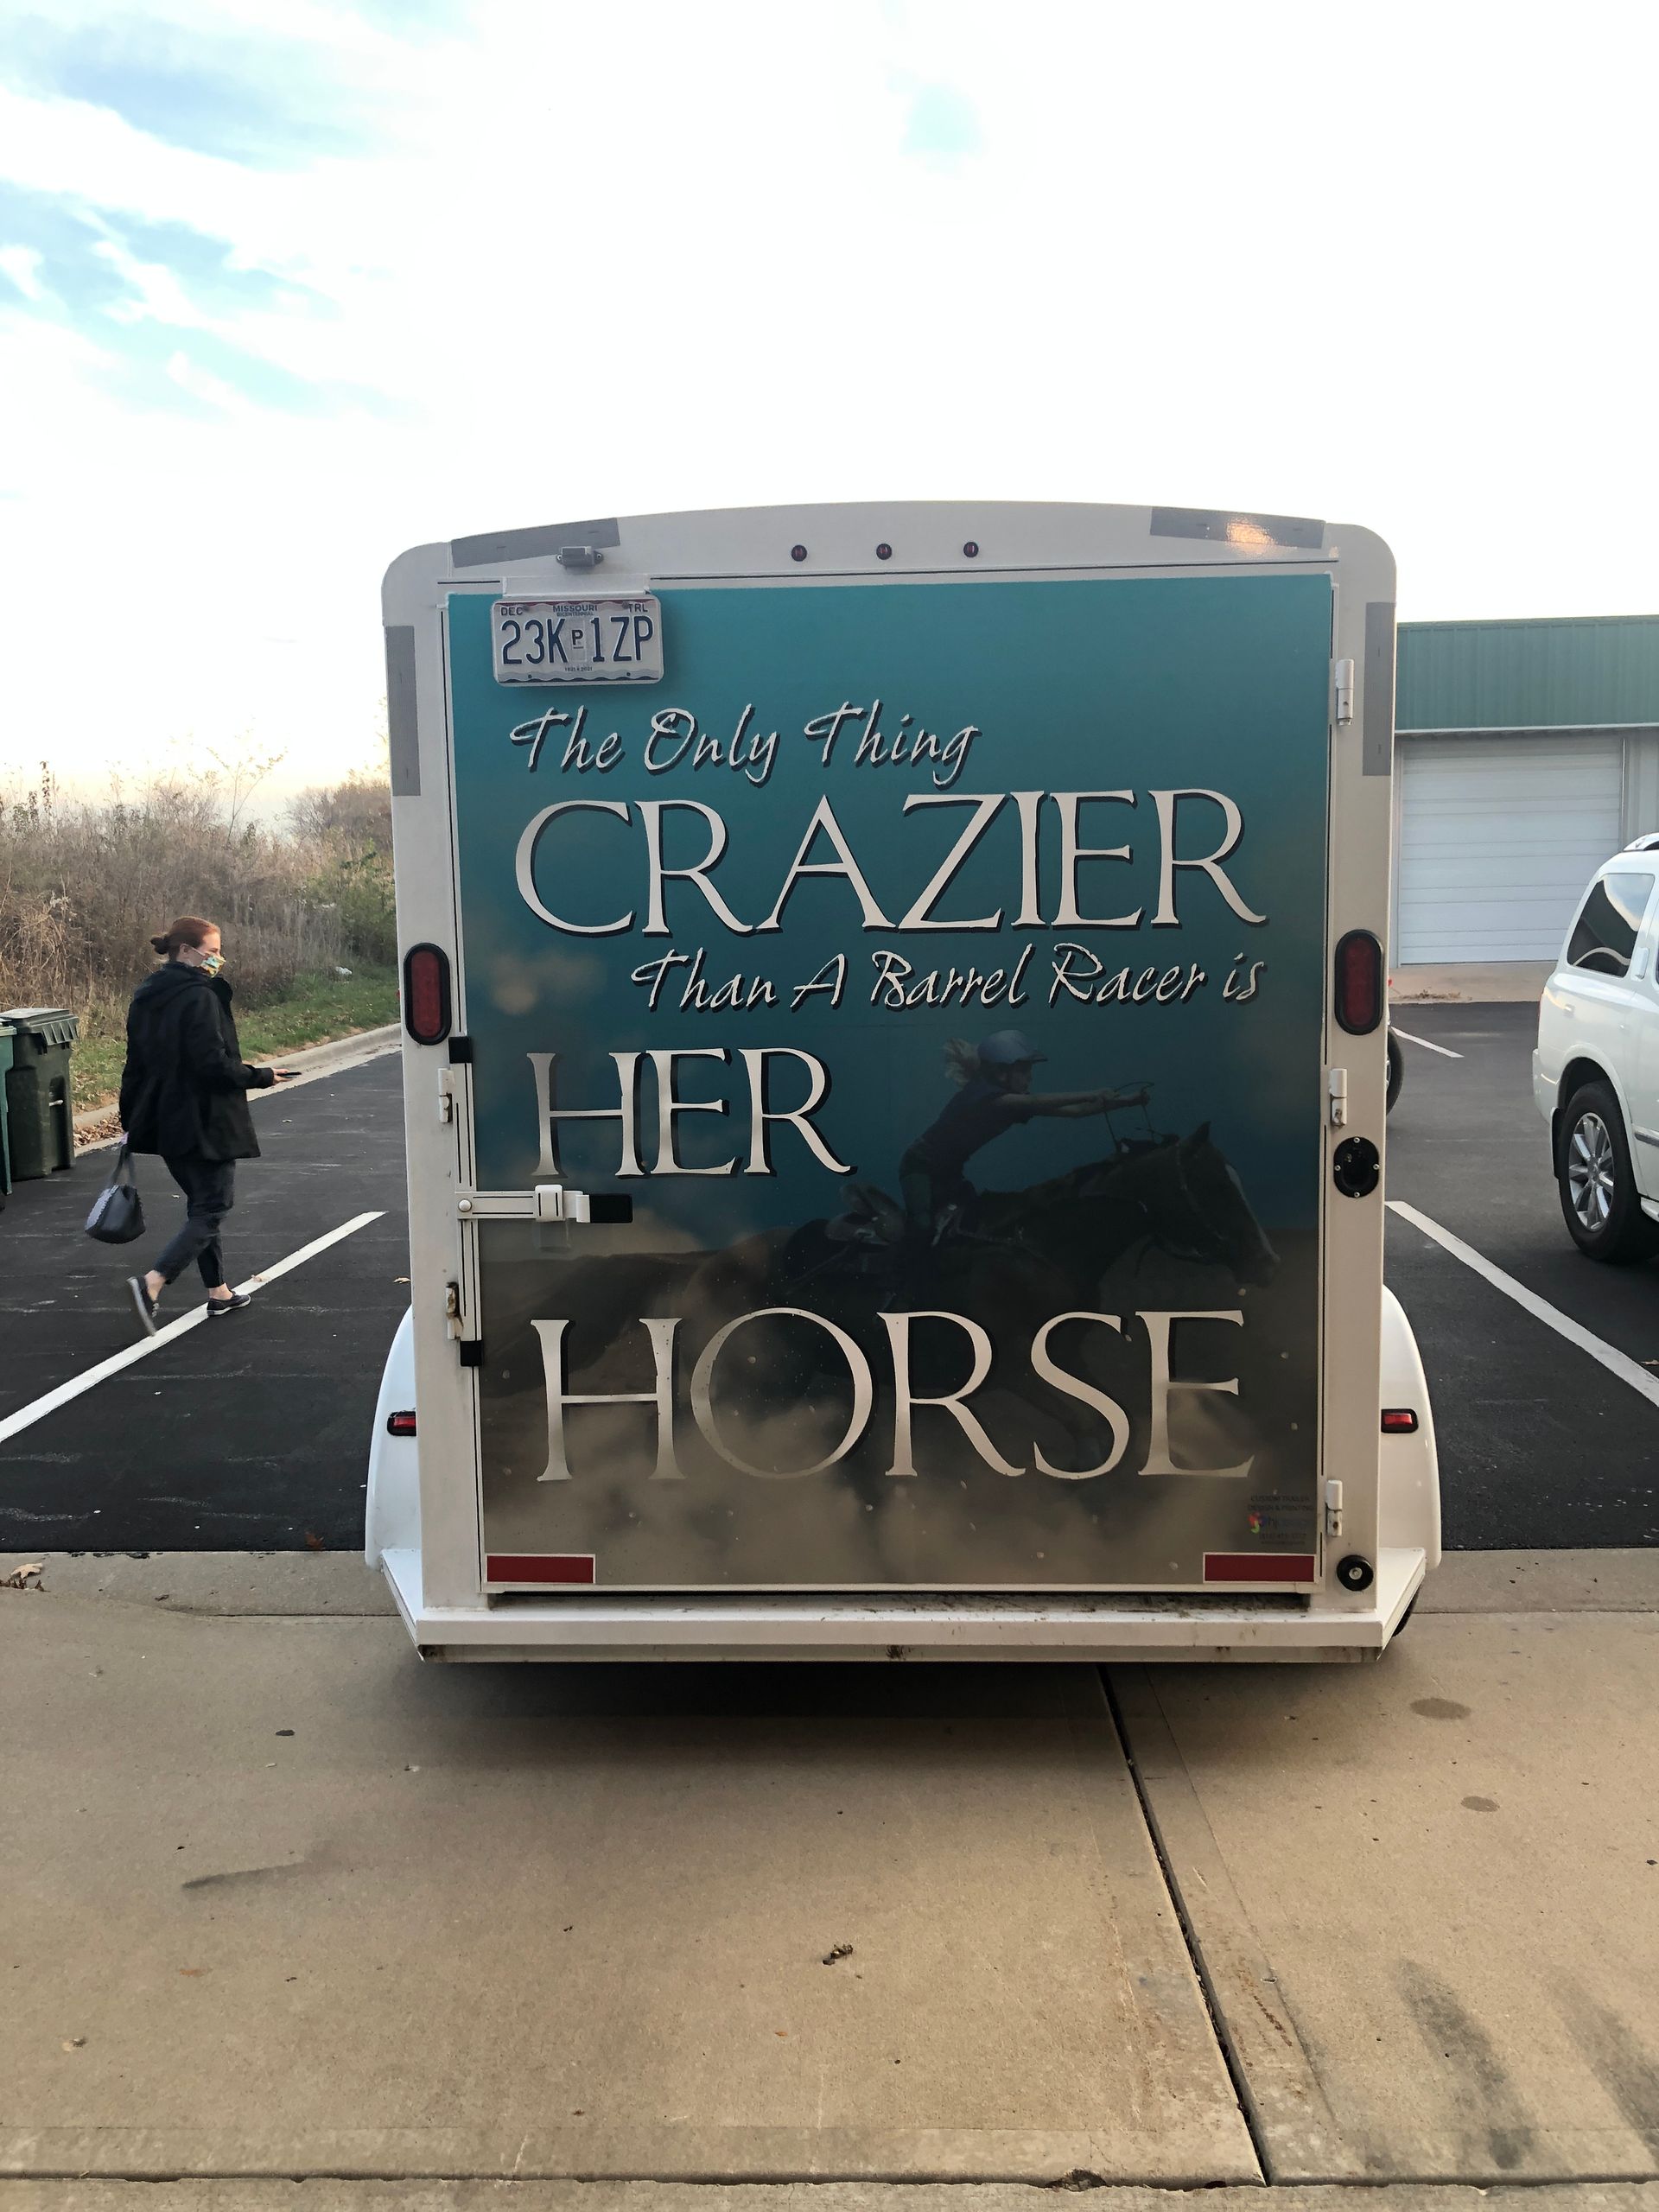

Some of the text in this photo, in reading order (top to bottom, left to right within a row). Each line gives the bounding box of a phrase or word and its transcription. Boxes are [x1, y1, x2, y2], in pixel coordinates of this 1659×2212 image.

[500, 607, 523, 616] DEC
[628, 603, 648, 613] TRL
[501, 615, 653, 664] 23K P 1ZP
[510, 699, 978, 785] The Only Thing
[516, 789, 1266, 932] CRAZIER
[631, 943, 1263, 1007] Than A Barrel Racer is
[527, 1048, 850, 1175] HER
[531, 1307, 1252, 1481] HORSE
